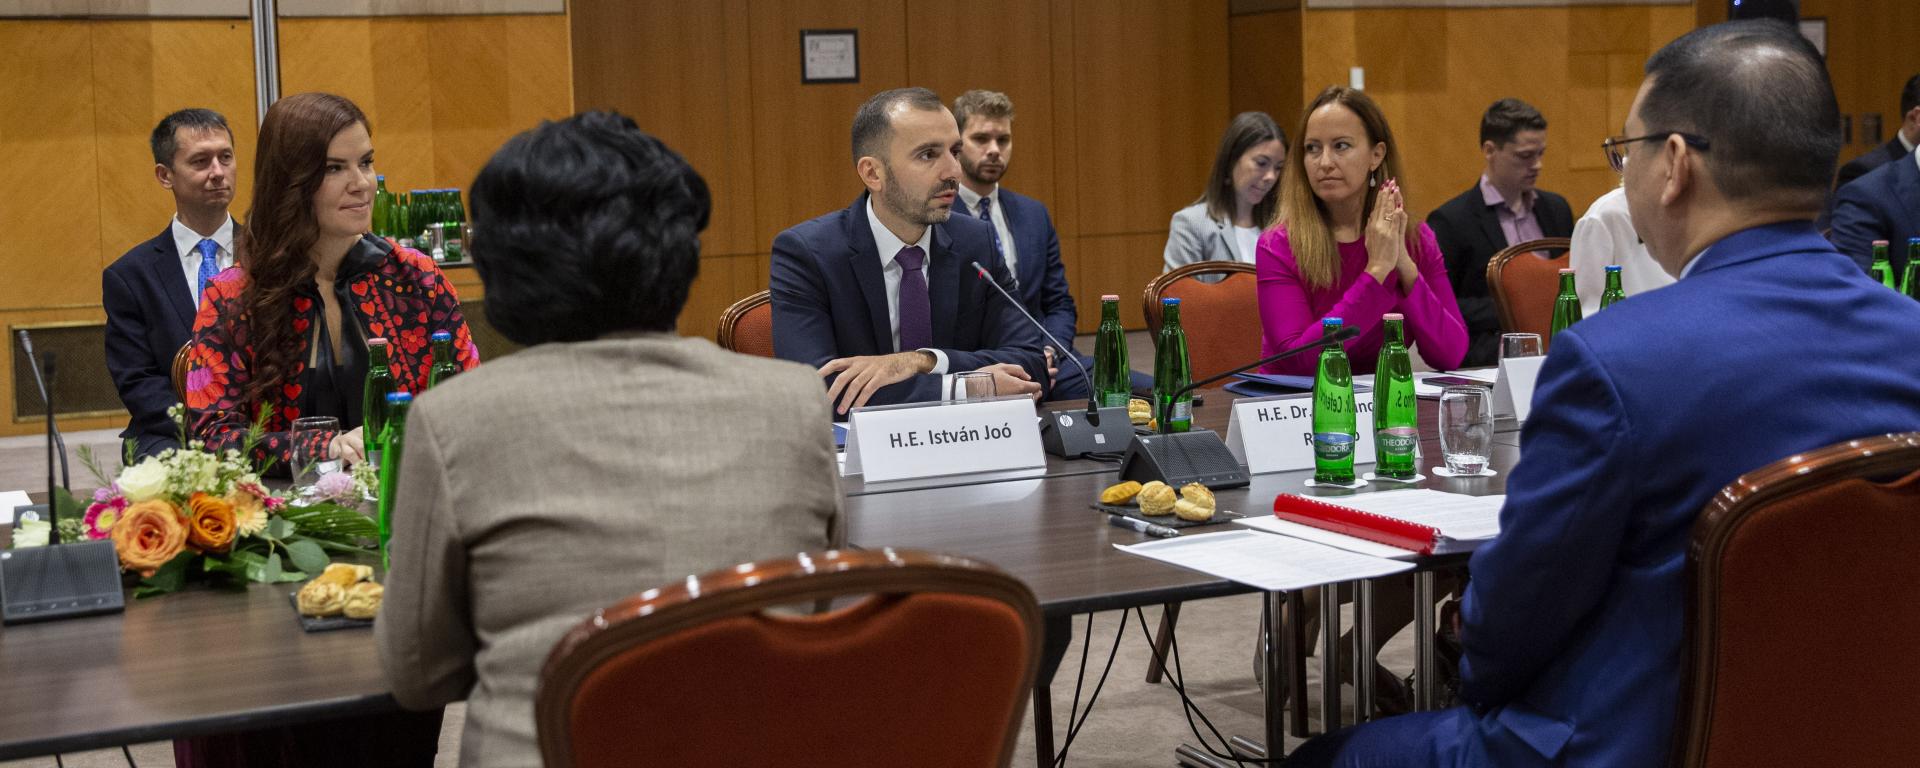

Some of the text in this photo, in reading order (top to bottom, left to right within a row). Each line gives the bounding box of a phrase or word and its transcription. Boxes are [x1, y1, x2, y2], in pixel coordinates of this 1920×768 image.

[1257, 405, 1312, 422] H.E. Dr.
[889, 422, 1012, 448] H.E. István Joó
